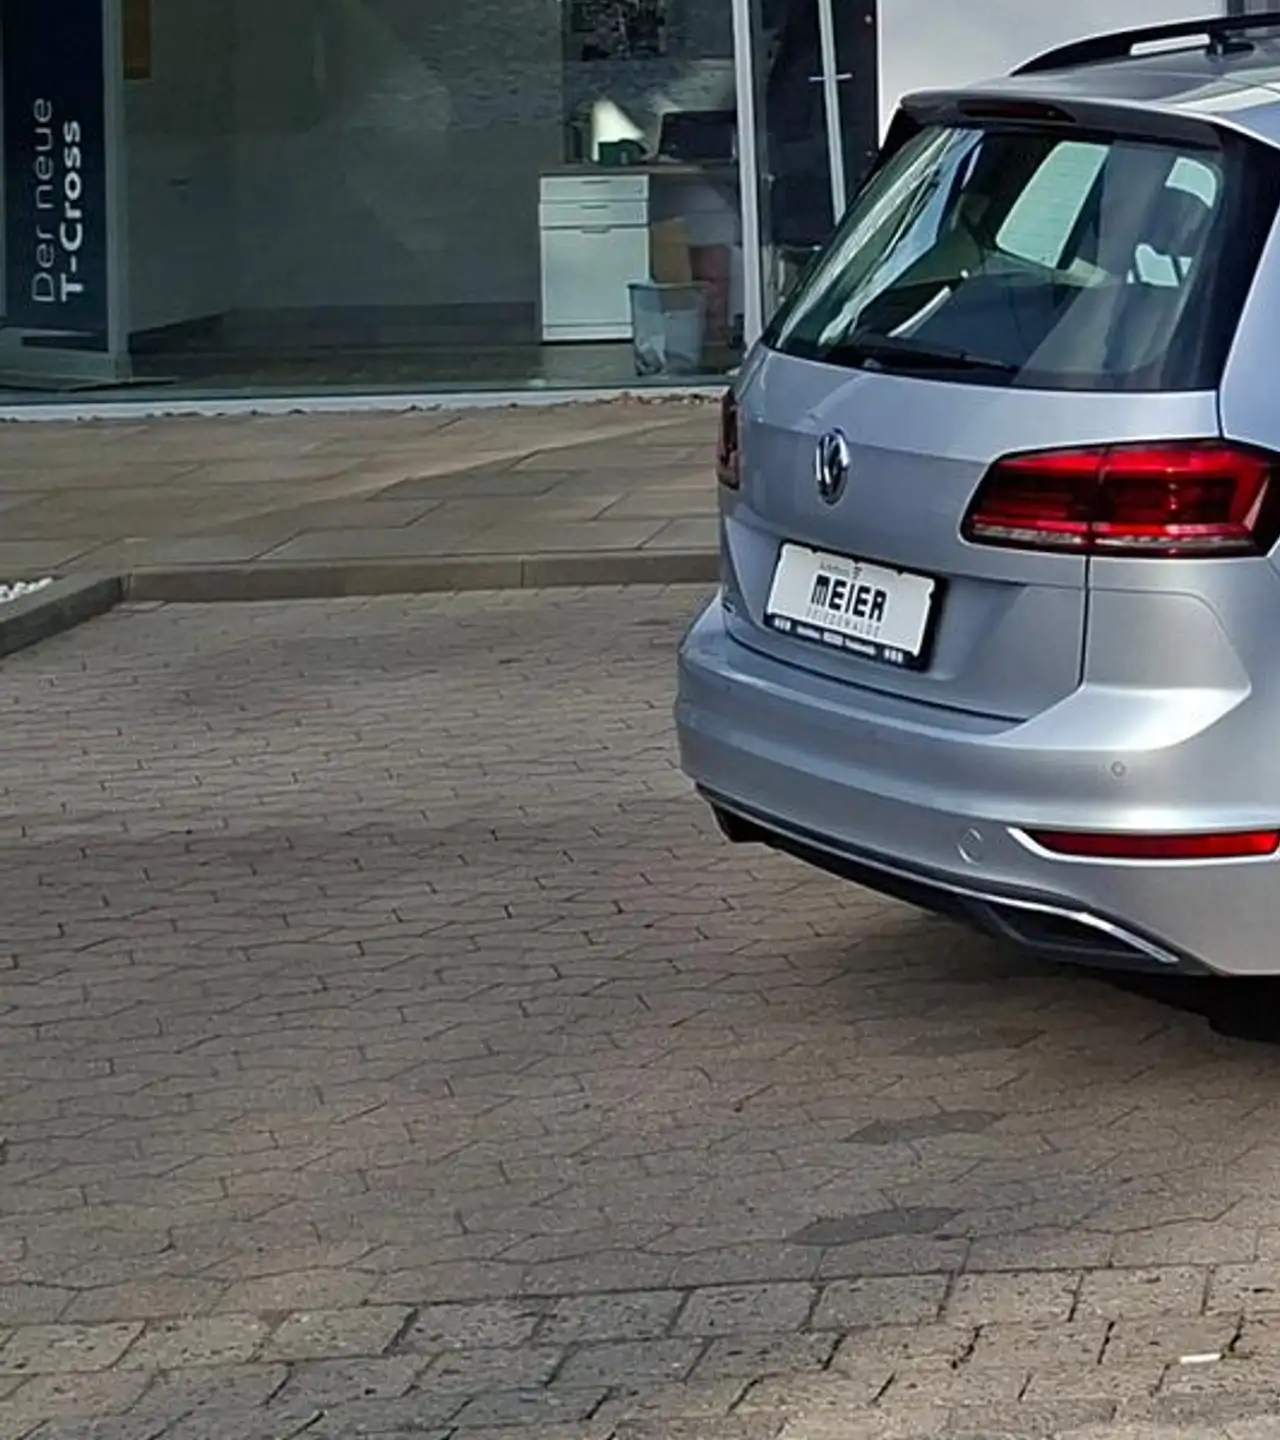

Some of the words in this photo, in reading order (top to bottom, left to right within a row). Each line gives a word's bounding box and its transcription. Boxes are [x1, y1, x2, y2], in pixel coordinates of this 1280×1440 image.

[33, 97, 55, 209] neue
[60, 119, 84, 302] T-Cross
[31, 224, 56, 302] Der
[810, 573, 888, 623] MEIER
